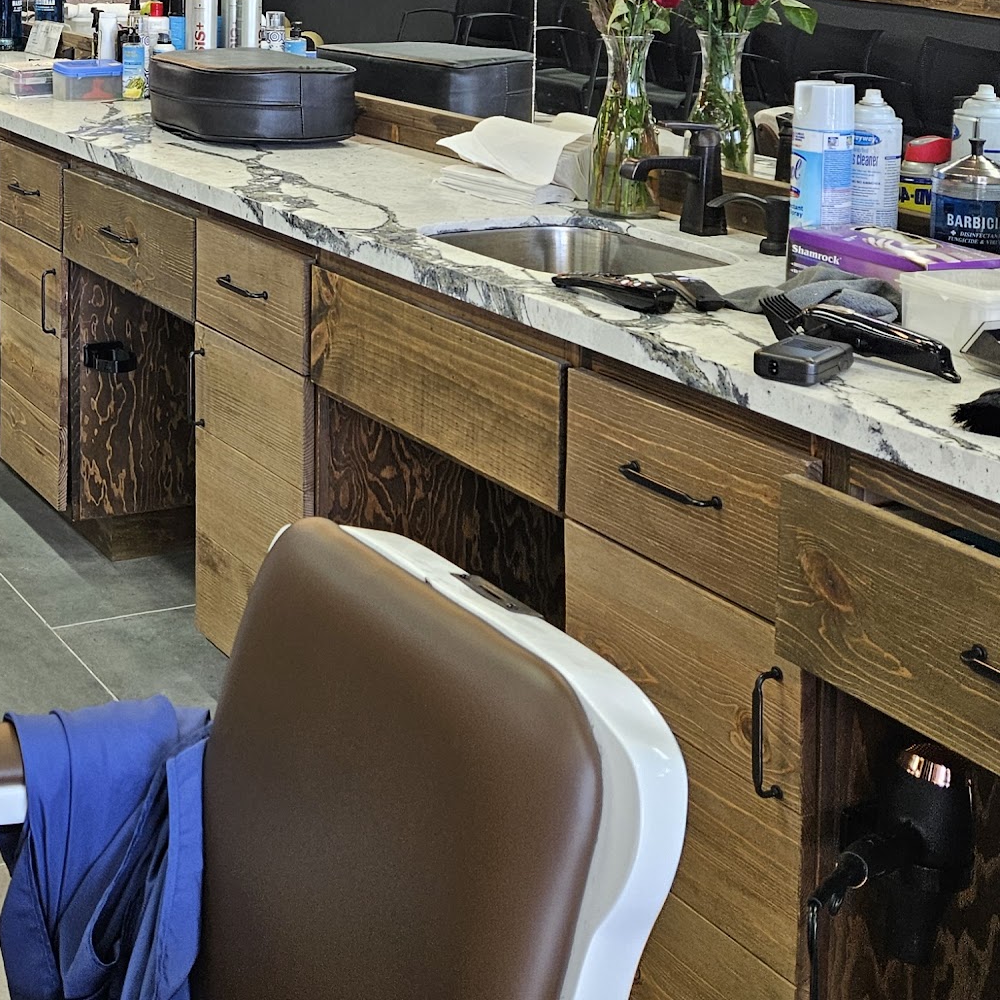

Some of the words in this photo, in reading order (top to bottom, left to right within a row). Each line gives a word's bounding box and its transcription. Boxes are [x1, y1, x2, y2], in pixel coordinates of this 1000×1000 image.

[857, 153, 879, 167] cleaner
[948, 236, 978, 244] FUNGICIDE
[792, 244, 840, 265] Shamrock
